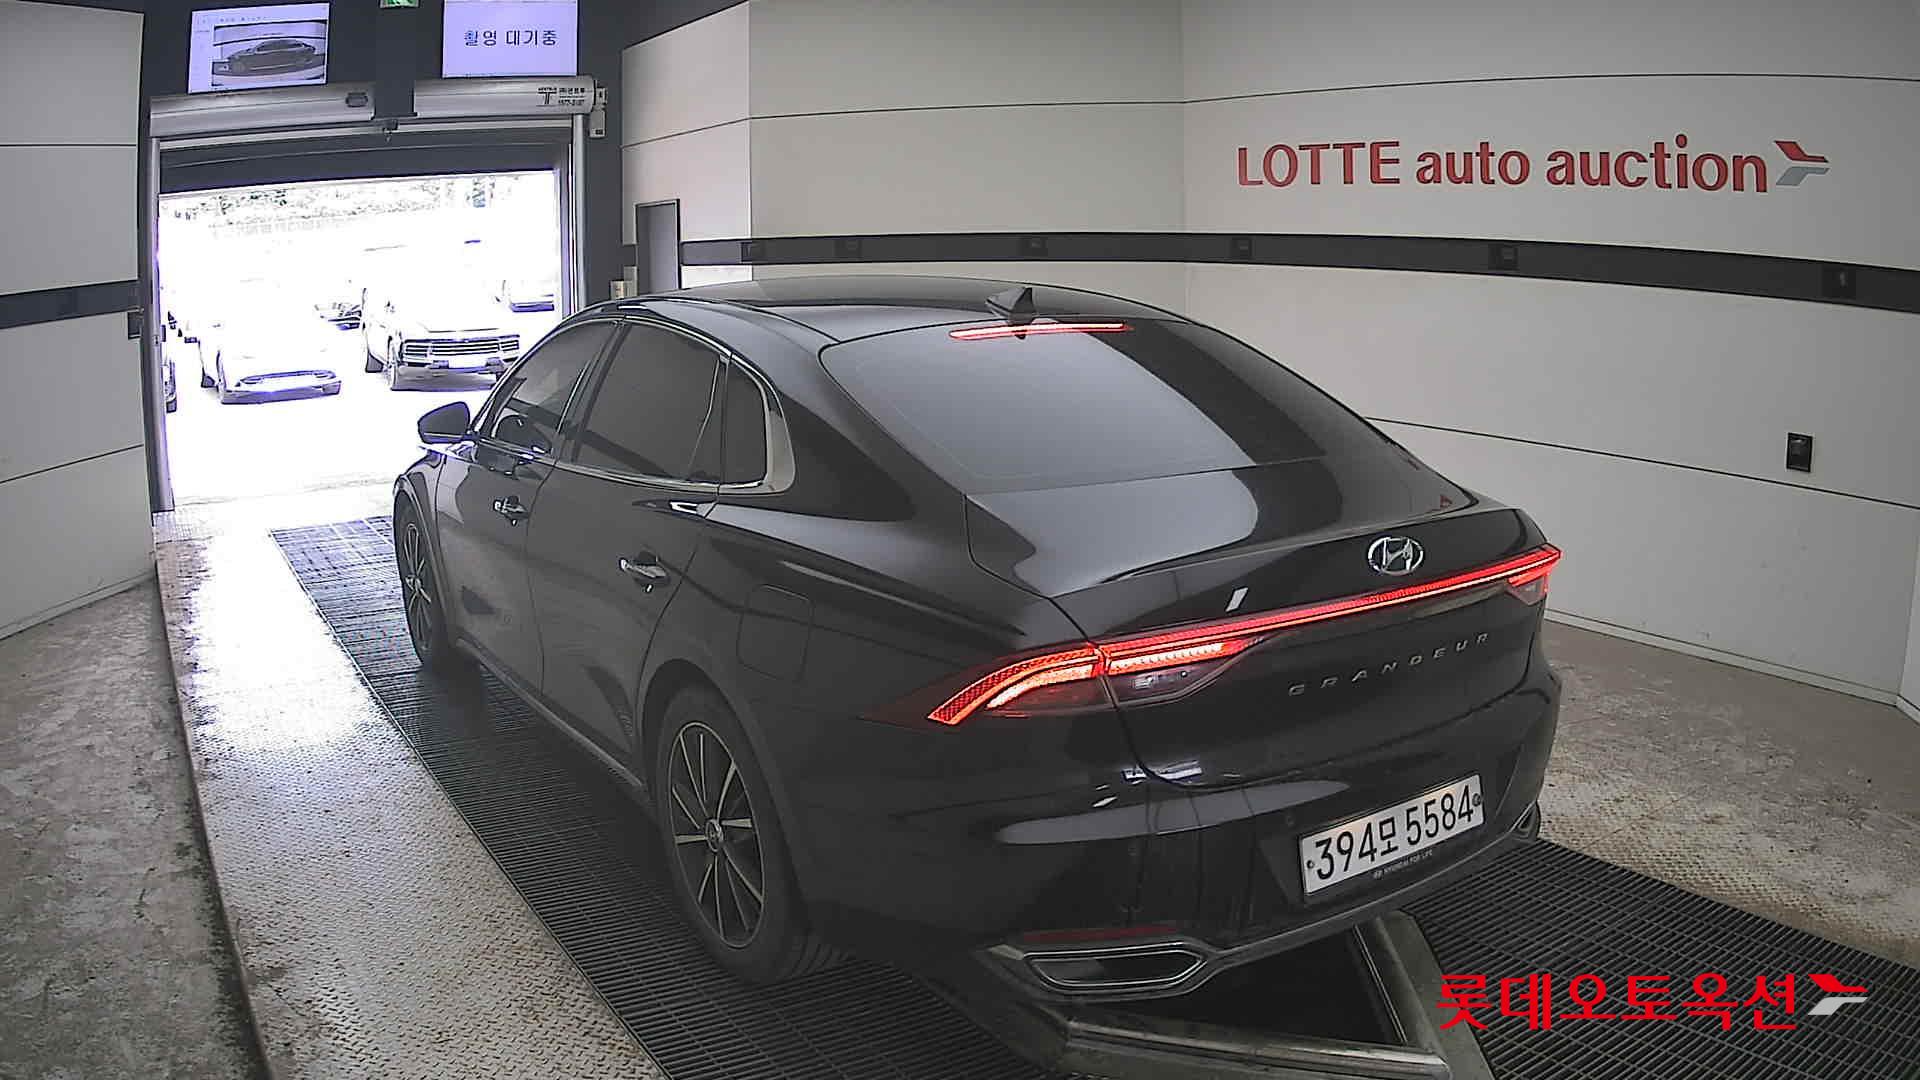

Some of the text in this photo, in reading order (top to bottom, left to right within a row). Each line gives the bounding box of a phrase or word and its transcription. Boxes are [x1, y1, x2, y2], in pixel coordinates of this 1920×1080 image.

[506, 30, 557, 46] 대기중
[1237, 133, 1768, 193] LOTTE auto auction
[1288, 632, 1489, 696] GRANDEUR
[1405, 785, 1474, 846] 5584
